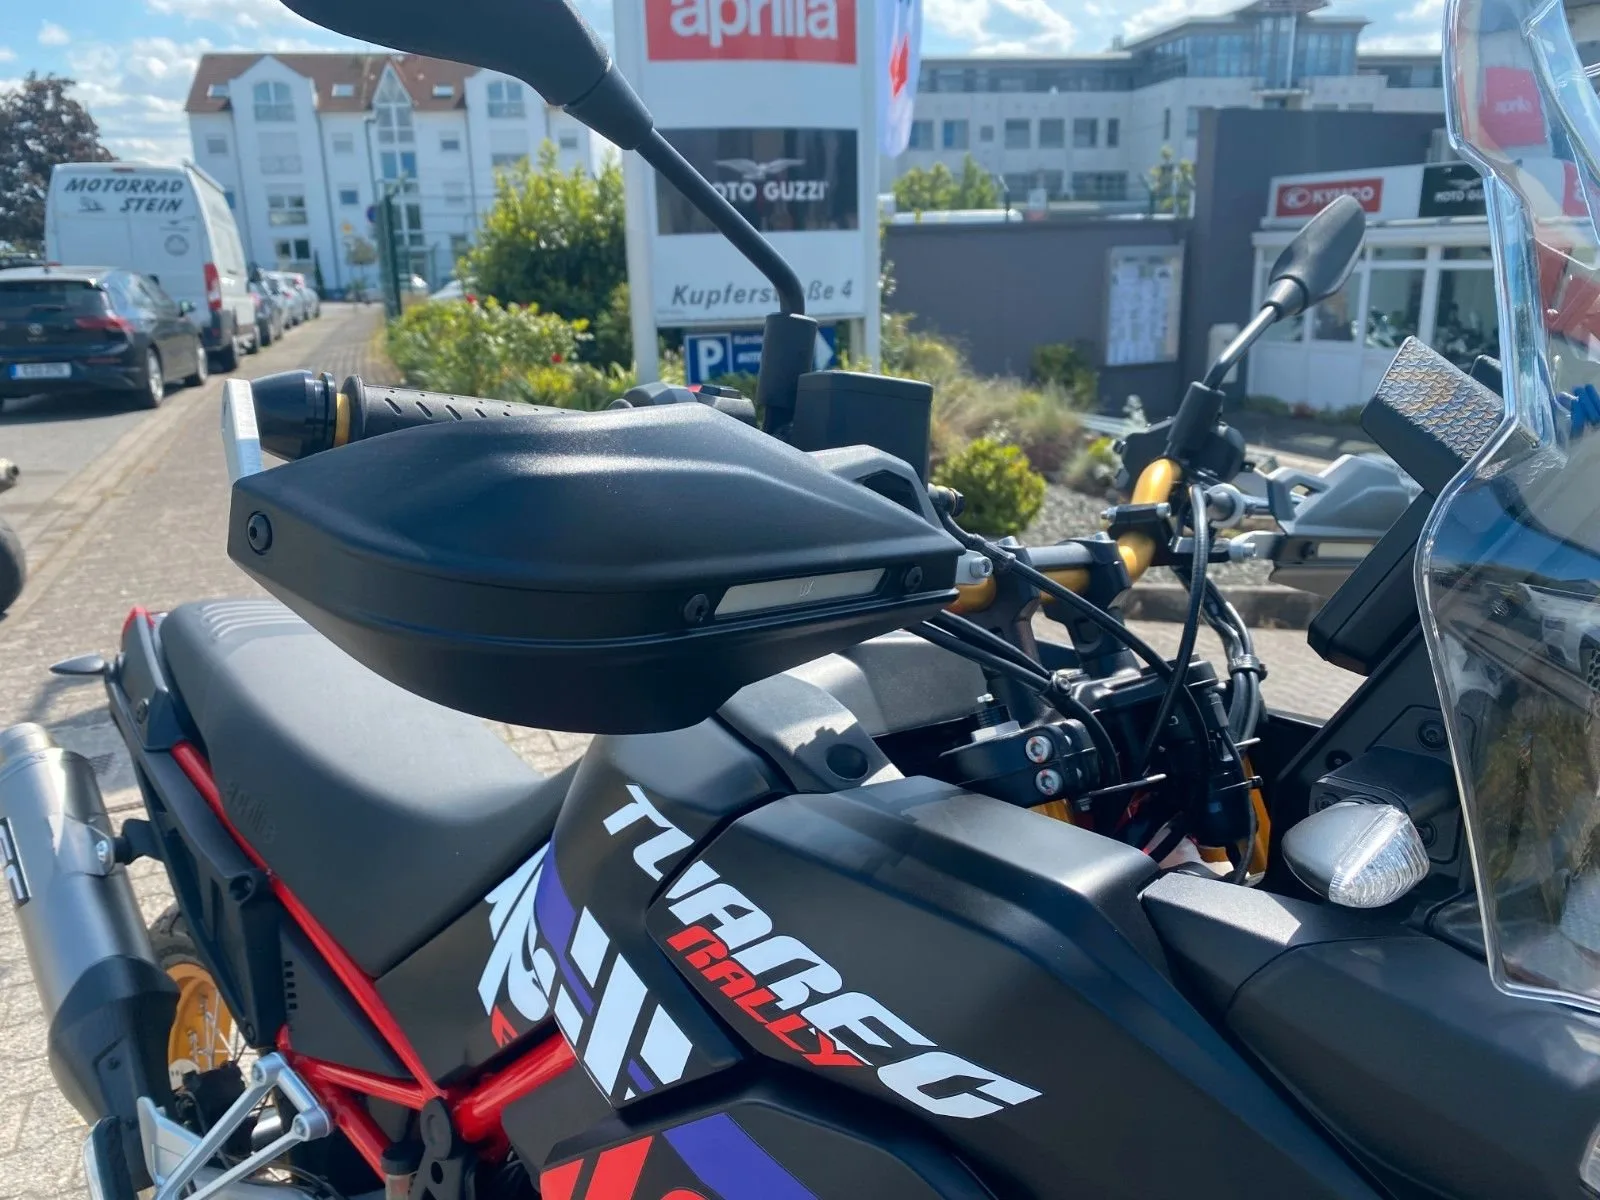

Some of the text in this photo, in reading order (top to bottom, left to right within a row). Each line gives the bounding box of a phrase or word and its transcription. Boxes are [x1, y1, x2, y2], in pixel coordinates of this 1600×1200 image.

[670, 0, 838, 48] aprilia
[64, 177, 184, 193] MOTORRAD
[711, 180, 825, 201] OTO GUZZI
[119, 197, 184, 213] STEIN
[840, 279, 853, 298] 4
[696, 339, 724, 381] P
[602, 783, 1043, 1119] TUAREG
[666, 924, 864, 1067] RALLY
